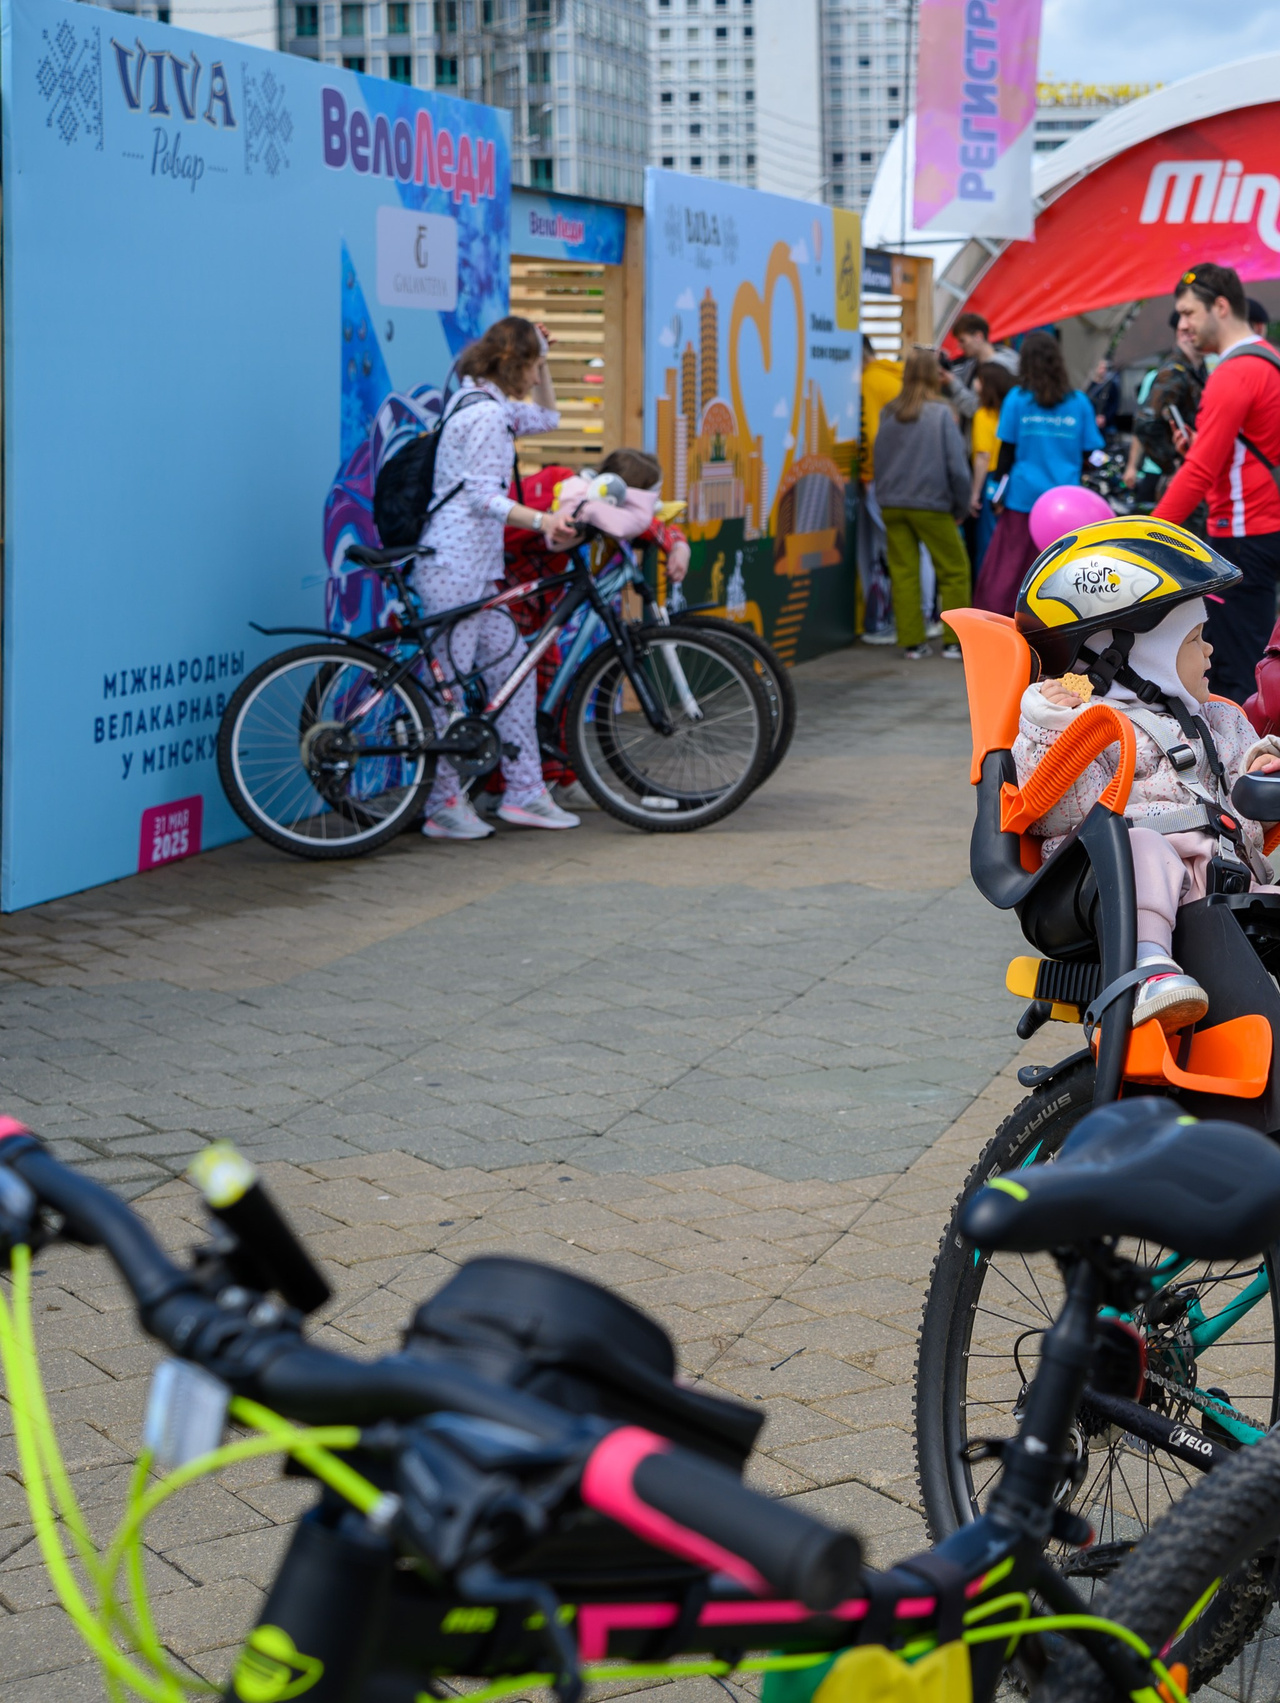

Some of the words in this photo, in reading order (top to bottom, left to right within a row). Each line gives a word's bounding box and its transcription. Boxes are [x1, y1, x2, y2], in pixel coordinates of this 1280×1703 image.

[110, 37, 238, 128] VIVA
[958, 0, 998, 201] РЕГИСТР
[321, 86, 496, 205] ВелоЛеди
[103, 650, 245, 700] МІЖНАРОДНЫ
[94, 692, 226, 744] ВЕЛАКАРНАВ
[121, 752, 134, 781] У
[152, 829, 190, 863] 2025
[1008, 1092, 1073, 1158] SMART
[1179, 1431, 1213, 1455] VELO
